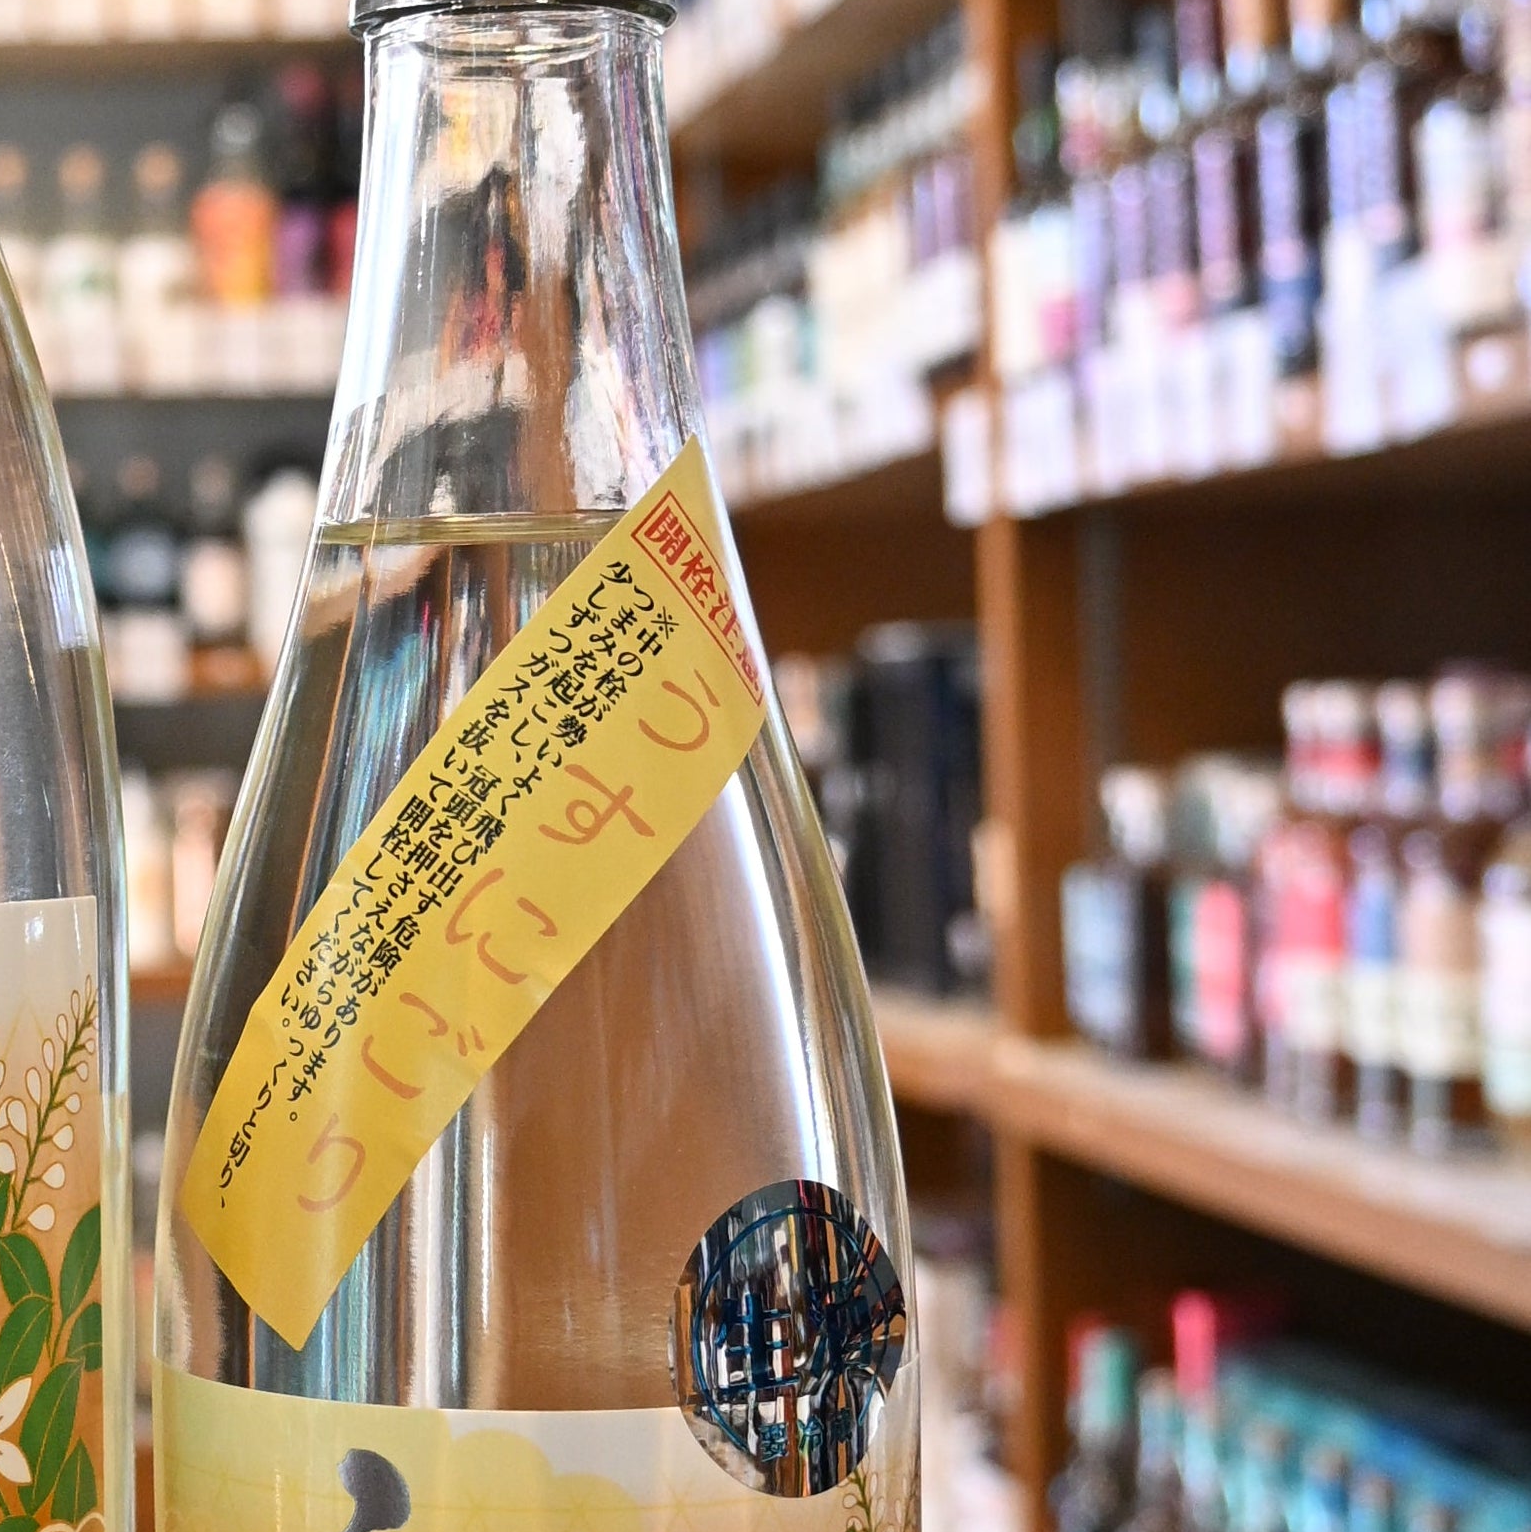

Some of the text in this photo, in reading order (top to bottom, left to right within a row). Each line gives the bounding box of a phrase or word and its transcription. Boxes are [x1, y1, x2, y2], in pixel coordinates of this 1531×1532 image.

[296, 667, 721, 1213] うすにごり
